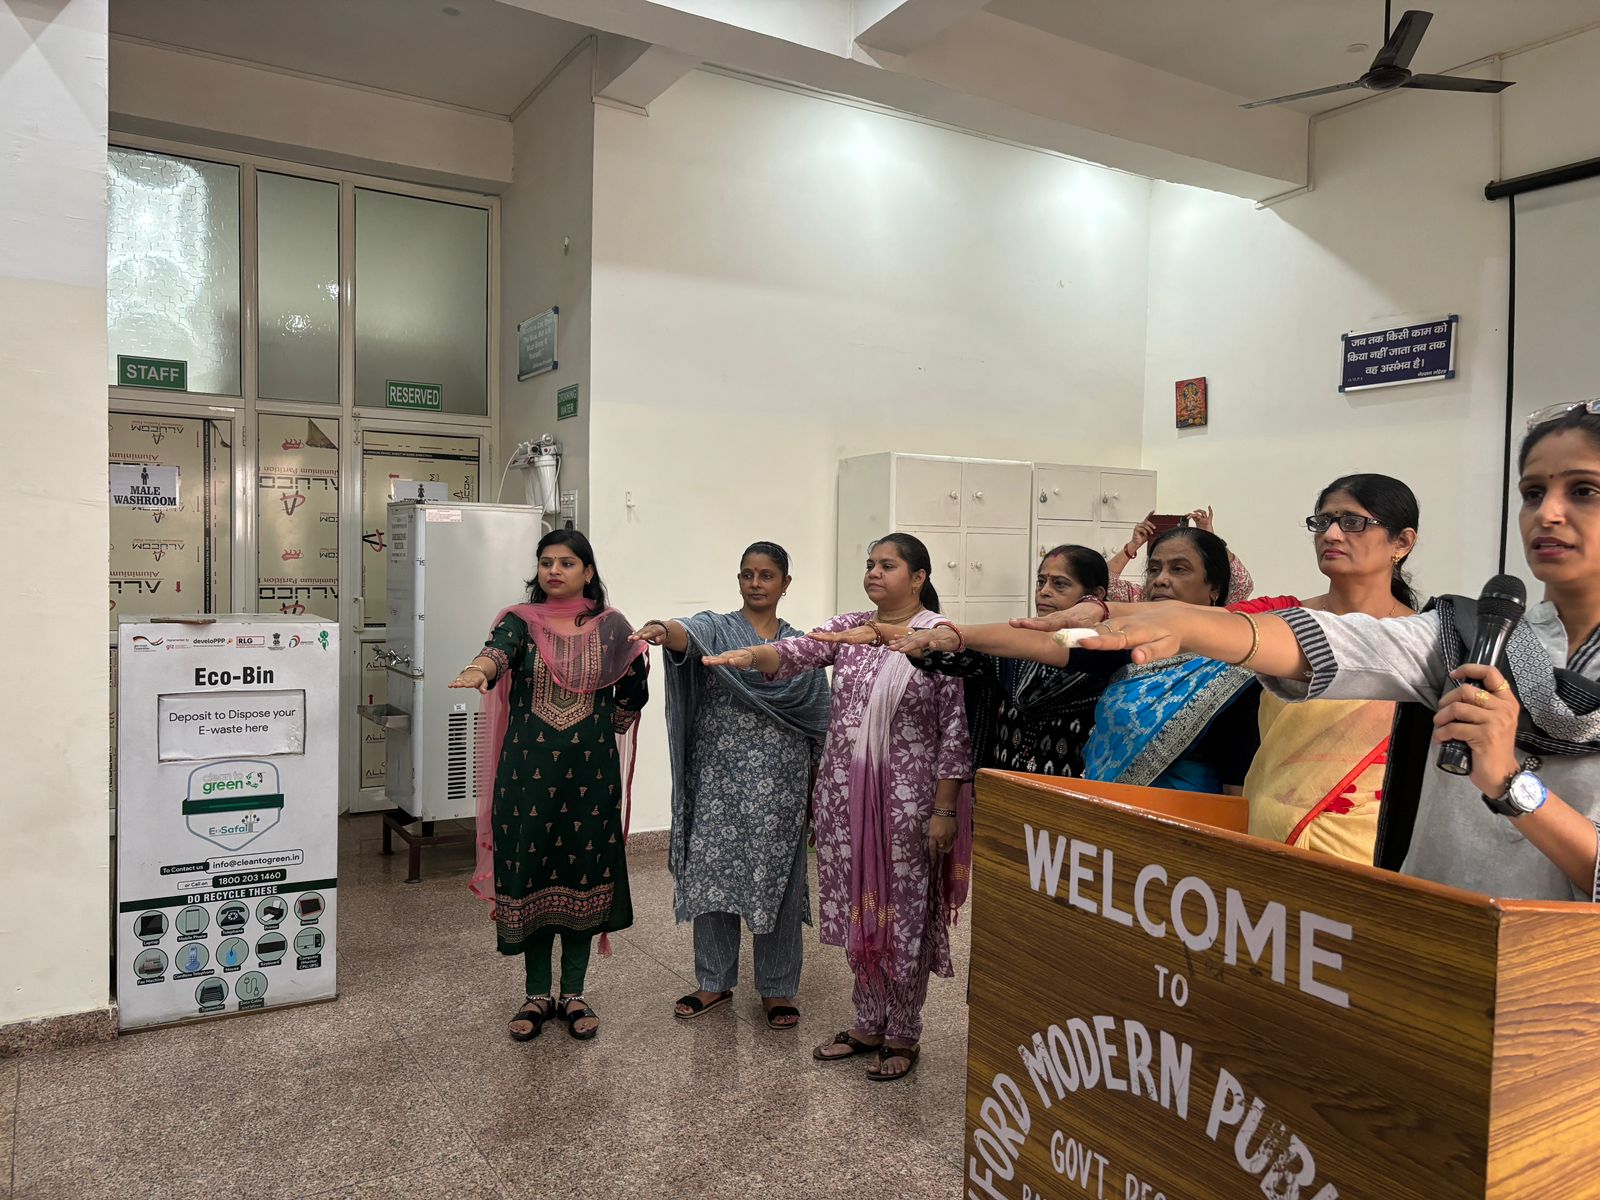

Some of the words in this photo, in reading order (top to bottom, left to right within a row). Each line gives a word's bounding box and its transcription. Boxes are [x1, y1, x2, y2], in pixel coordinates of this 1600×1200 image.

[1368, 335, 1385, 345] तक
[1386, 328, 1409, 342] किसी
[1411, 326, 1431, 338] काम
[1434, 322, 1448, 334] को
[1347, 351, 1368, 363] किया
[1370, 347, 1389, 360] नहीं
[1389, 345, 1410, 357] जाता
[1429, 340, 1447, 350] तक
[126, 364, 180, 383] STAFF
[1365, 365, 1380, 375] वह
[1380, 360, 1411, 373] असंभव
[389, 386, 440, 406] RESERVED
[299, 467, 338, 476] luminium
[130, 485, 160, 496] MALE
[113, 495, 177, 506] WASHROOM
[264, 577, 298, 585] Partition
[299, 578, 338, 586] luminium
[193, 637, 226, 645] develoPPP
[194, 666, 274, 686] Eco-Bin
[169, 710, 212, 723] Deposit
[215, 711, 226, 720] to
[228, 709, 271, 721] Dispose
[272, 708, 297, 719] your
[198, 724, 243, 735] E-waste
[245, 723, 269, 733] here
[203, 779, 244, 795] green
[212, 853, 300, 869] info@cleantogreen.in
[171, 865, 196, 873] Contact
[219, 875, 240, 885] 1800
[242, 874, 259, 883] 203
[261, 871, 281, 881] 1460
[187, 894, 200, 904] DO
[203, 889, 246, 902] RECYCLE
[249, 885, 278, 897] THESE
[1023, 823, 1353, 1008] WELCOME
[1154, 964, 1189, 1008] TO
[968, 1072, 1031, 1200] FORD
[1018, 1014, 1193, 1121] MODERN
[1205, 1067, 1339, 1200] PUB
